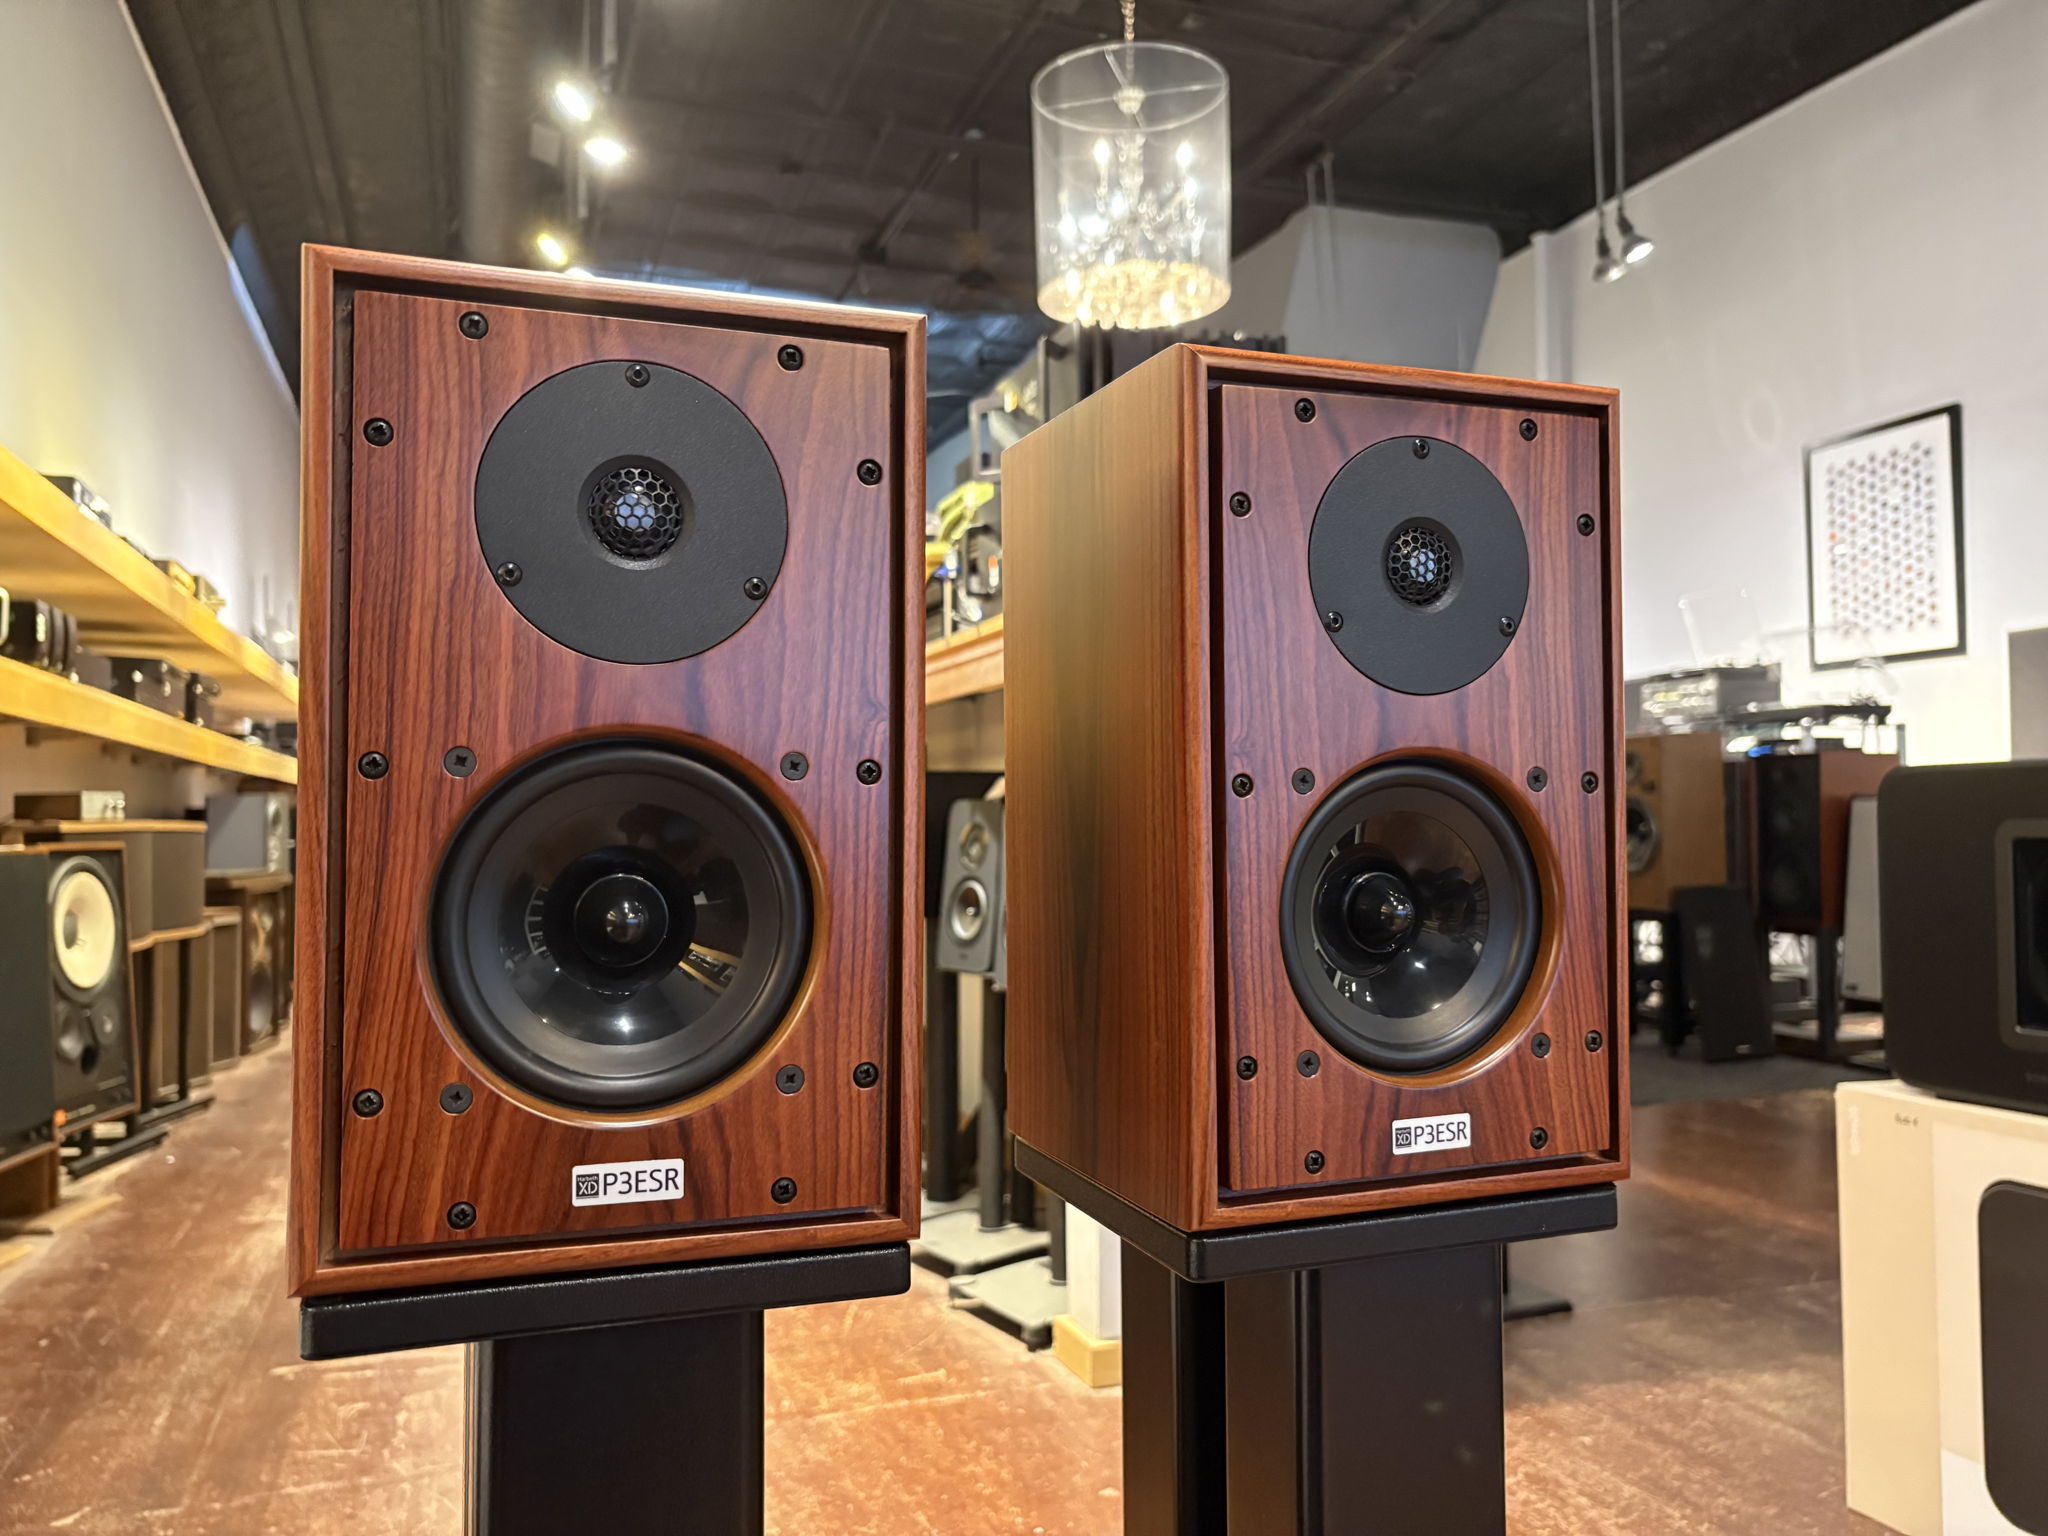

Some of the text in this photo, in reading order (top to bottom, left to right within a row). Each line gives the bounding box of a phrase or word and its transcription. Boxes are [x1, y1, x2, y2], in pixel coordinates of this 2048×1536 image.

[1414, 1121, 1468, 1146] P3ESR
[578, 1181, 598, 1196] XD
[603, 1168, 680, 1196] P3ESR
